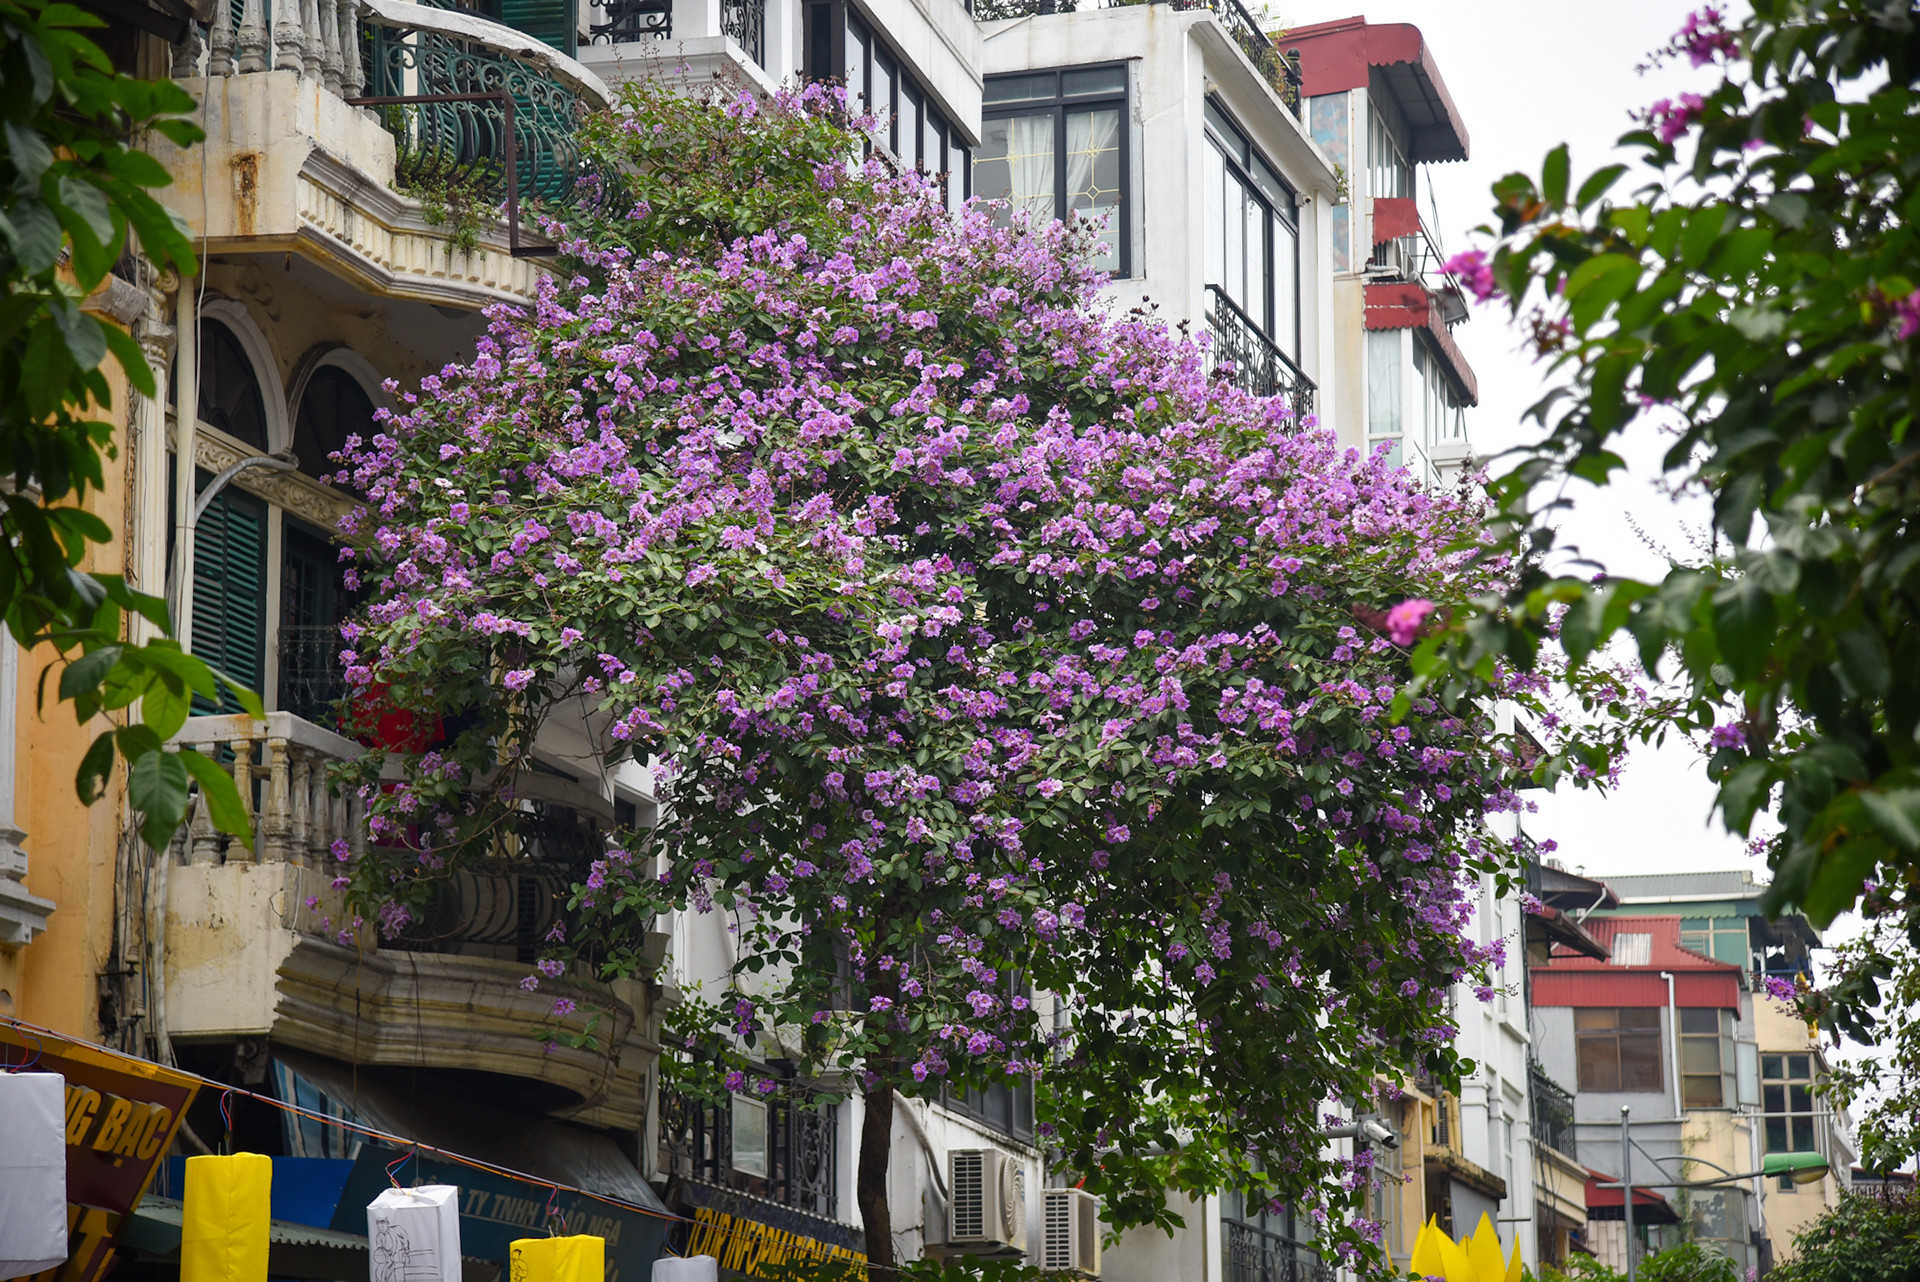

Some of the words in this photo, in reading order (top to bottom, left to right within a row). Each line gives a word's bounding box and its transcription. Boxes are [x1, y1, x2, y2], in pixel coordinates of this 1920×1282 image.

[92, 1095, 172, 1167] BẠC
[463, 1189, 490, 1215] TY
[489, 1194, 541, 1225] TNHH
[587, 1215, 622, 1242] NGA
[688, 1208, 731, 1266] TOUR
